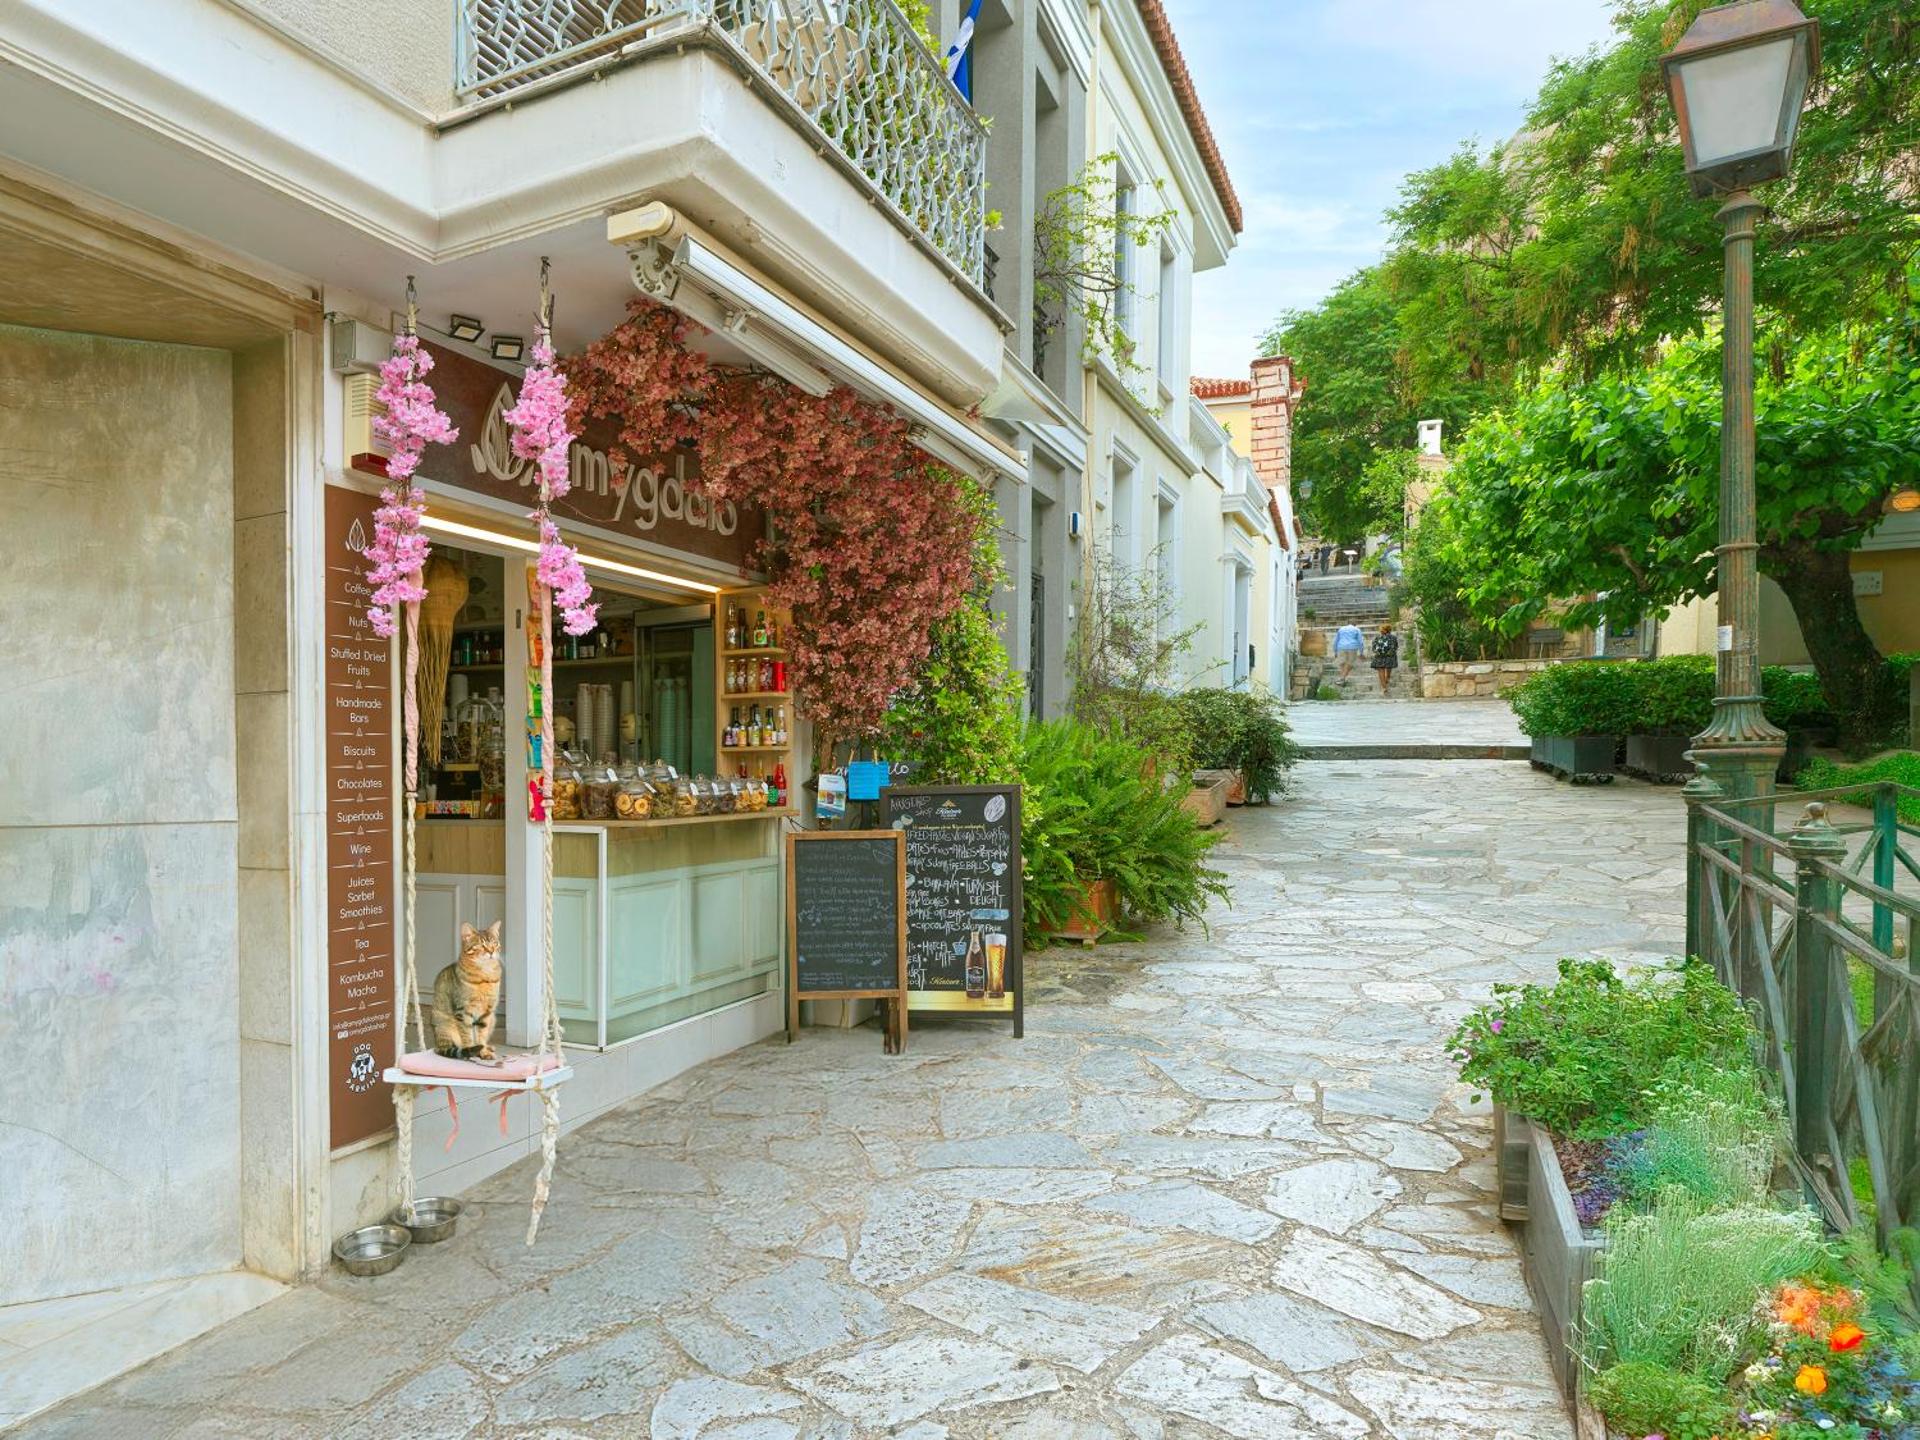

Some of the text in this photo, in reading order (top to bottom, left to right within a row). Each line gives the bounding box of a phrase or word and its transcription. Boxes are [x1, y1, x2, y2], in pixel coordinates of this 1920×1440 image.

[344, 582, 371, 596] Coffee
[348, 615, 368, 628] Nuts
[331, 647, 386, 663] Stuffed Dried
[347, 664, 370, 676] Fruits
[336, 696, 382, 709] Handmade
[350, 712, 369, 723] Bars
[343, 745, 376, 756] Biscuits
[337, 777, 383, 789] Chocolates
[337, 810, 384, 824] Superfoods
[350, 844, 372, 855] Wine
[348, 877, 375, 888] Juices
[347, 890, 375, 903] Sorbet
[340, 905, 383, 919] Smoothies
[354, 939, 370, 949] Tea
[340, 968, 384, 984] Kombucha
[347, 985, 377, 999] Macha
[354, 1043, 371, 1054] DOG
[346, 1071, 380, 1093] PARKING
